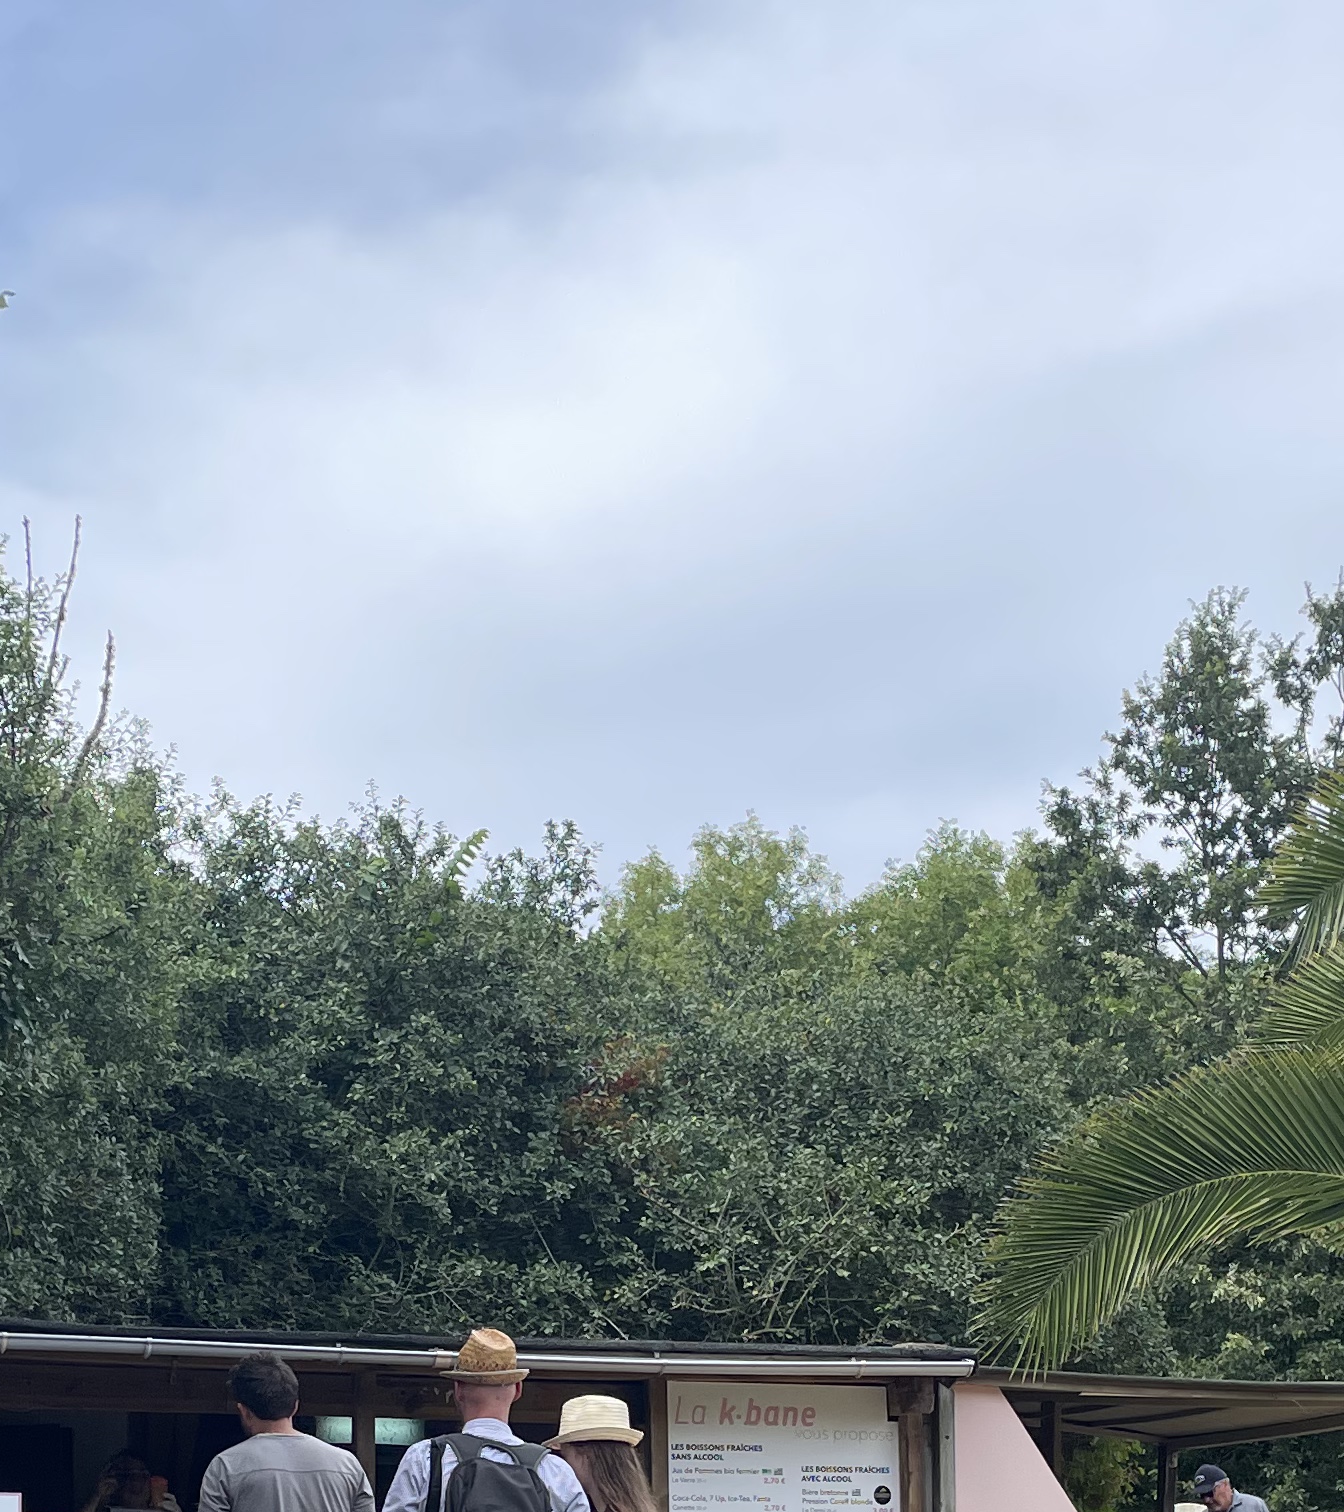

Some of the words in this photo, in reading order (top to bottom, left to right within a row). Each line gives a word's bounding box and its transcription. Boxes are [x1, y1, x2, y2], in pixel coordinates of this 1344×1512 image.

[674, 1395, 706, 1425] La
[794, 1428, 829, 1441] vous
[833, 1428, 896, 1443] propose
[670, 1443, 685, 1451] LES
[685, 1443, 725, 1452] BOISSONS
[670, 1453, 692, 1461] SANS
[693, 1453, 725, 1461] ALCOOL
[800, 1465, 814, 1473] LES
[815, 1465, 854, 1474] BOISSONS
[801, 1475, 822, 1483] AVEC
[822, 1475, 853, 1483] ALCOOL
